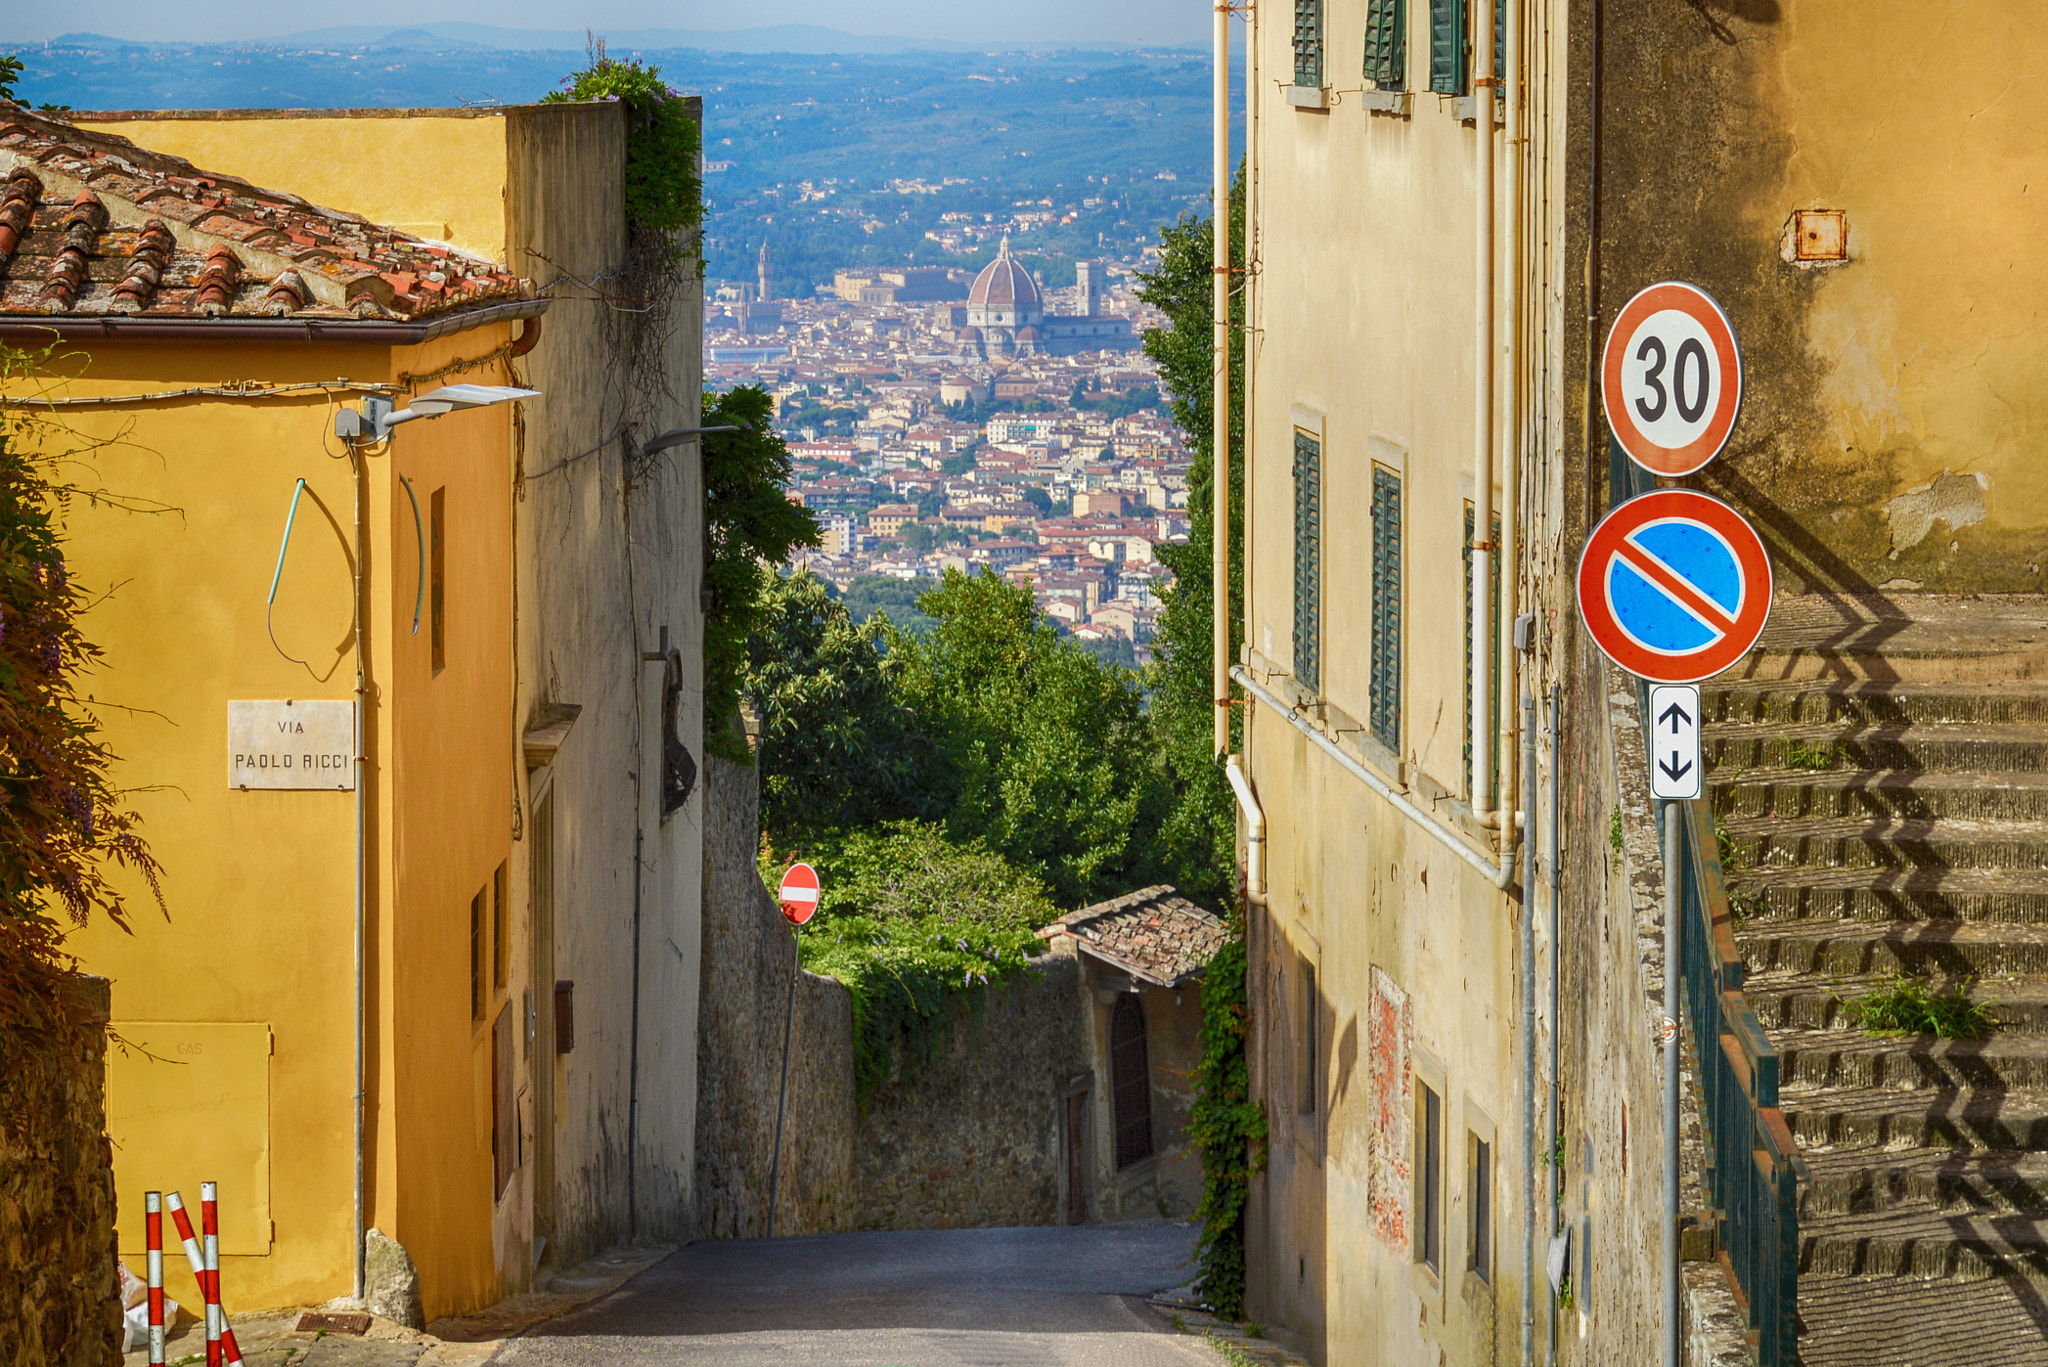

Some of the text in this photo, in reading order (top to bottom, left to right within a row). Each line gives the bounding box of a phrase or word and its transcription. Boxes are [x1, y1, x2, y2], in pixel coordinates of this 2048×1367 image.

[1635, 335, 1710, 424] 30
[277, 721, 304, 733] VIA
[235, 754, 347, 768] PAOLO RICCI
